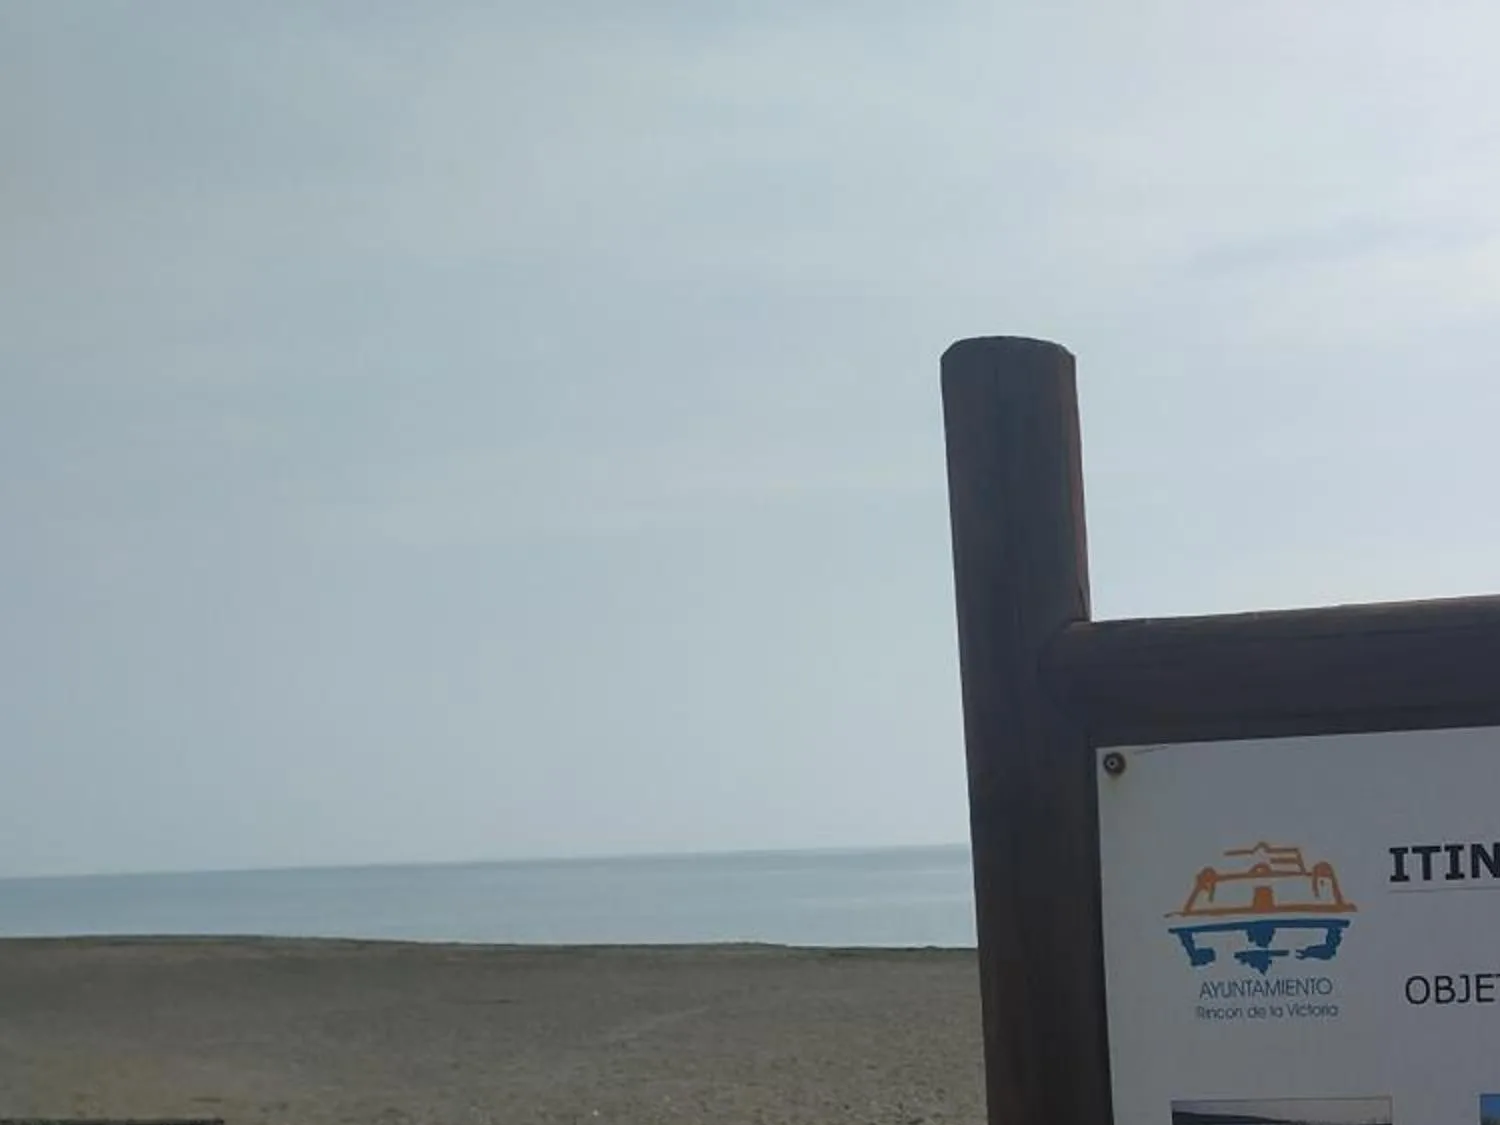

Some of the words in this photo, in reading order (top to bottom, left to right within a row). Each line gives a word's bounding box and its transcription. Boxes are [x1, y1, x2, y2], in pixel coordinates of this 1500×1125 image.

[1198, 973, 1334, 999] AYUNTAMIENTO
[1246, 1005, 1267, 1020] de
[1268, 1004, 1284, 1019] la
[1285, 1002, 1339, 1018] Victoria
